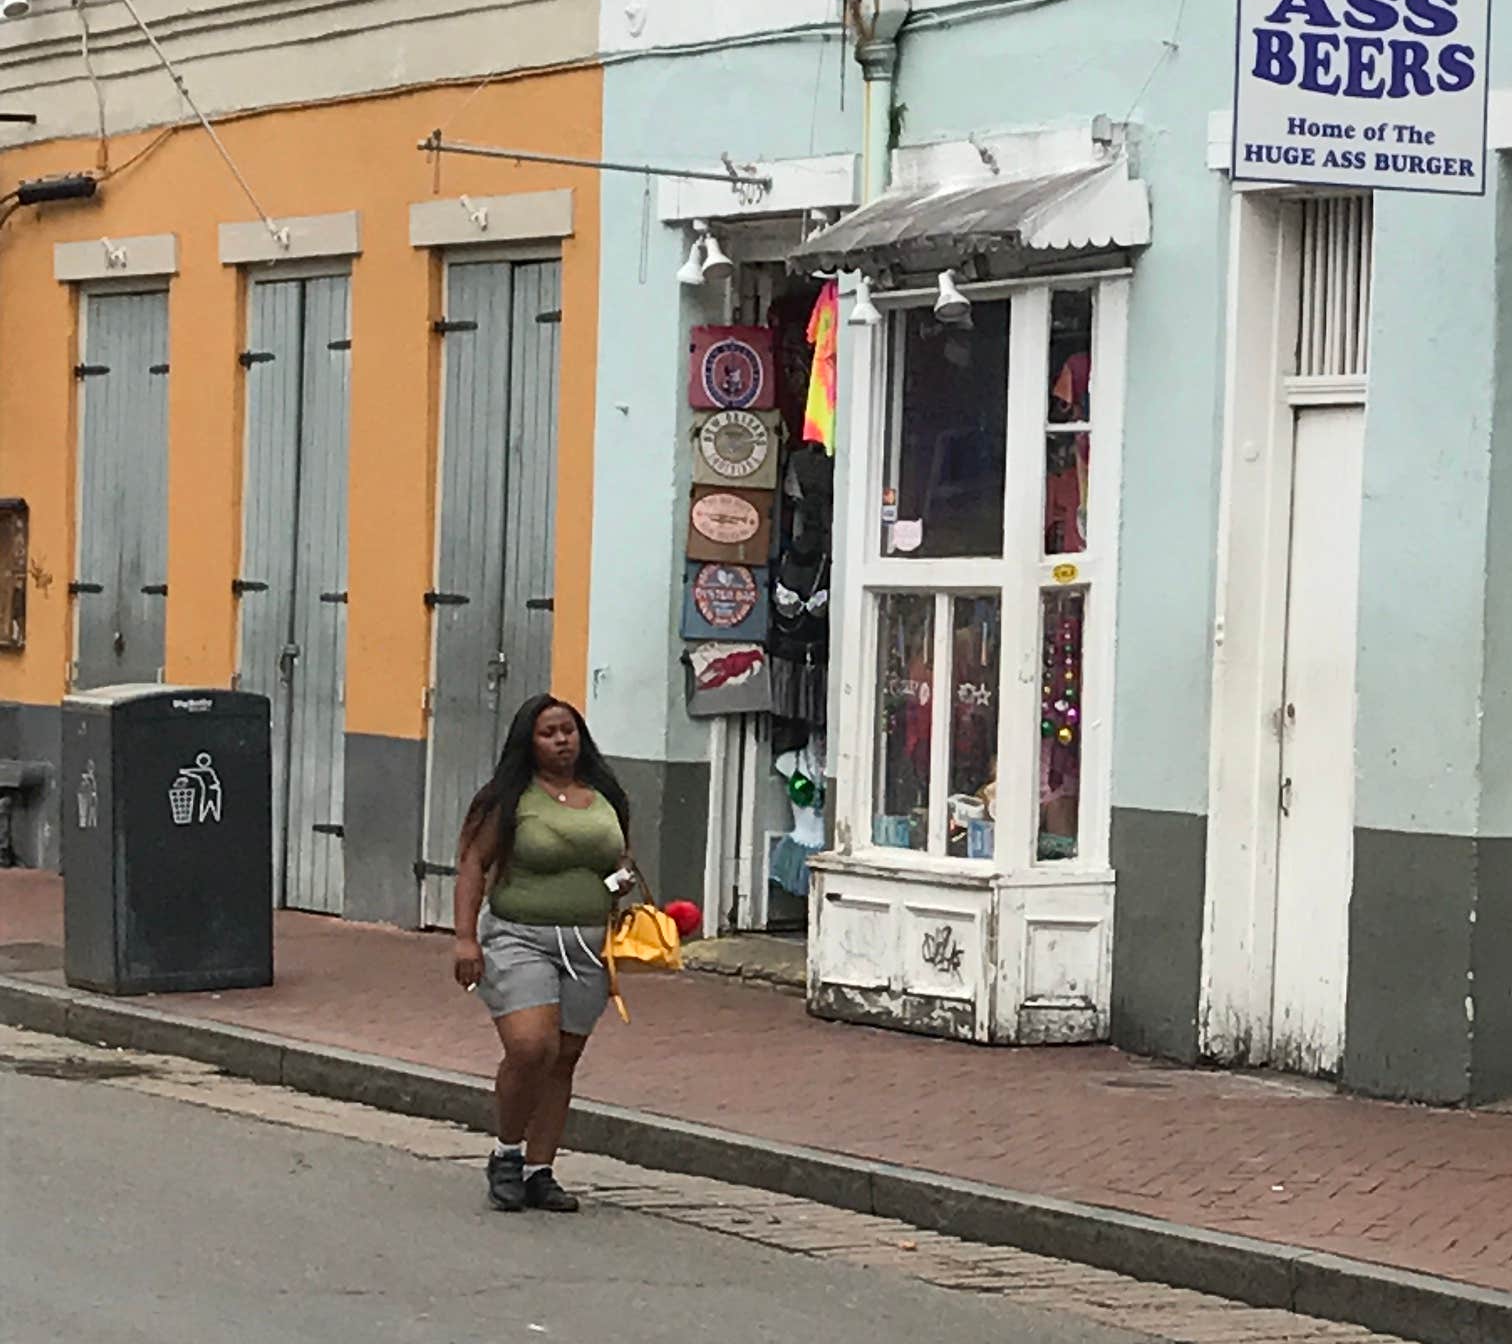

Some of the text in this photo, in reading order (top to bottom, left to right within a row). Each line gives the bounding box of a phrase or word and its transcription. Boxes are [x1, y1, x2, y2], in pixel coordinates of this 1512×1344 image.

[1252, 27, 1475, 99] BEERS
[1287, 117, 1436, 145] Home of The
[1244, 143, 1475, 176] HUGE ASS BURGER
